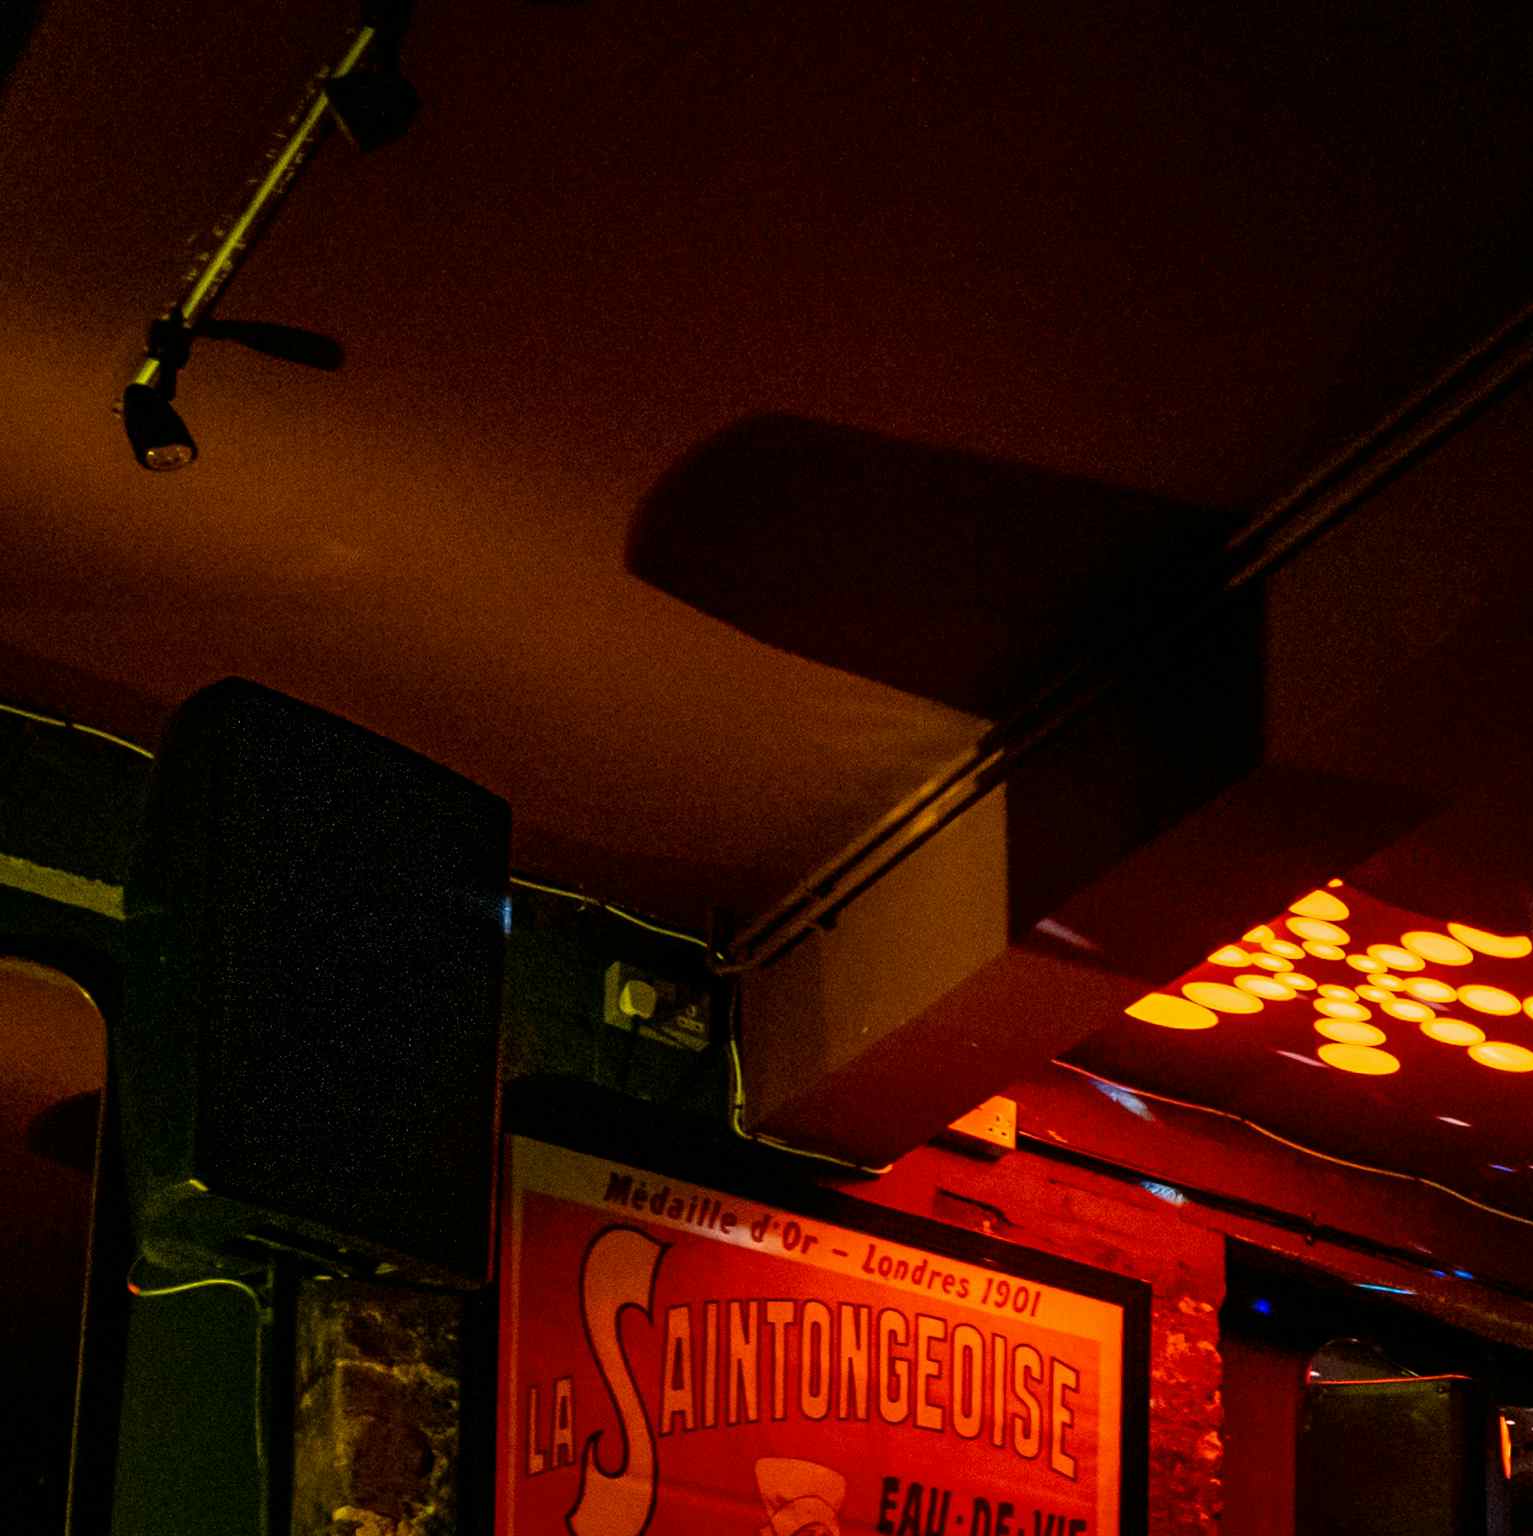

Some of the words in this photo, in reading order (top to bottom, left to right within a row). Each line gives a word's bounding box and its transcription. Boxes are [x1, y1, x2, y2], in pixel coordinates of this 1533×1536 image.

[750, 1208, 817, 1253] d'Or
[861, 1244, 971, 1299] Londres
[981, 1281, 1042, 1317] 1901
[525, 1375, 575, 1478] LA
